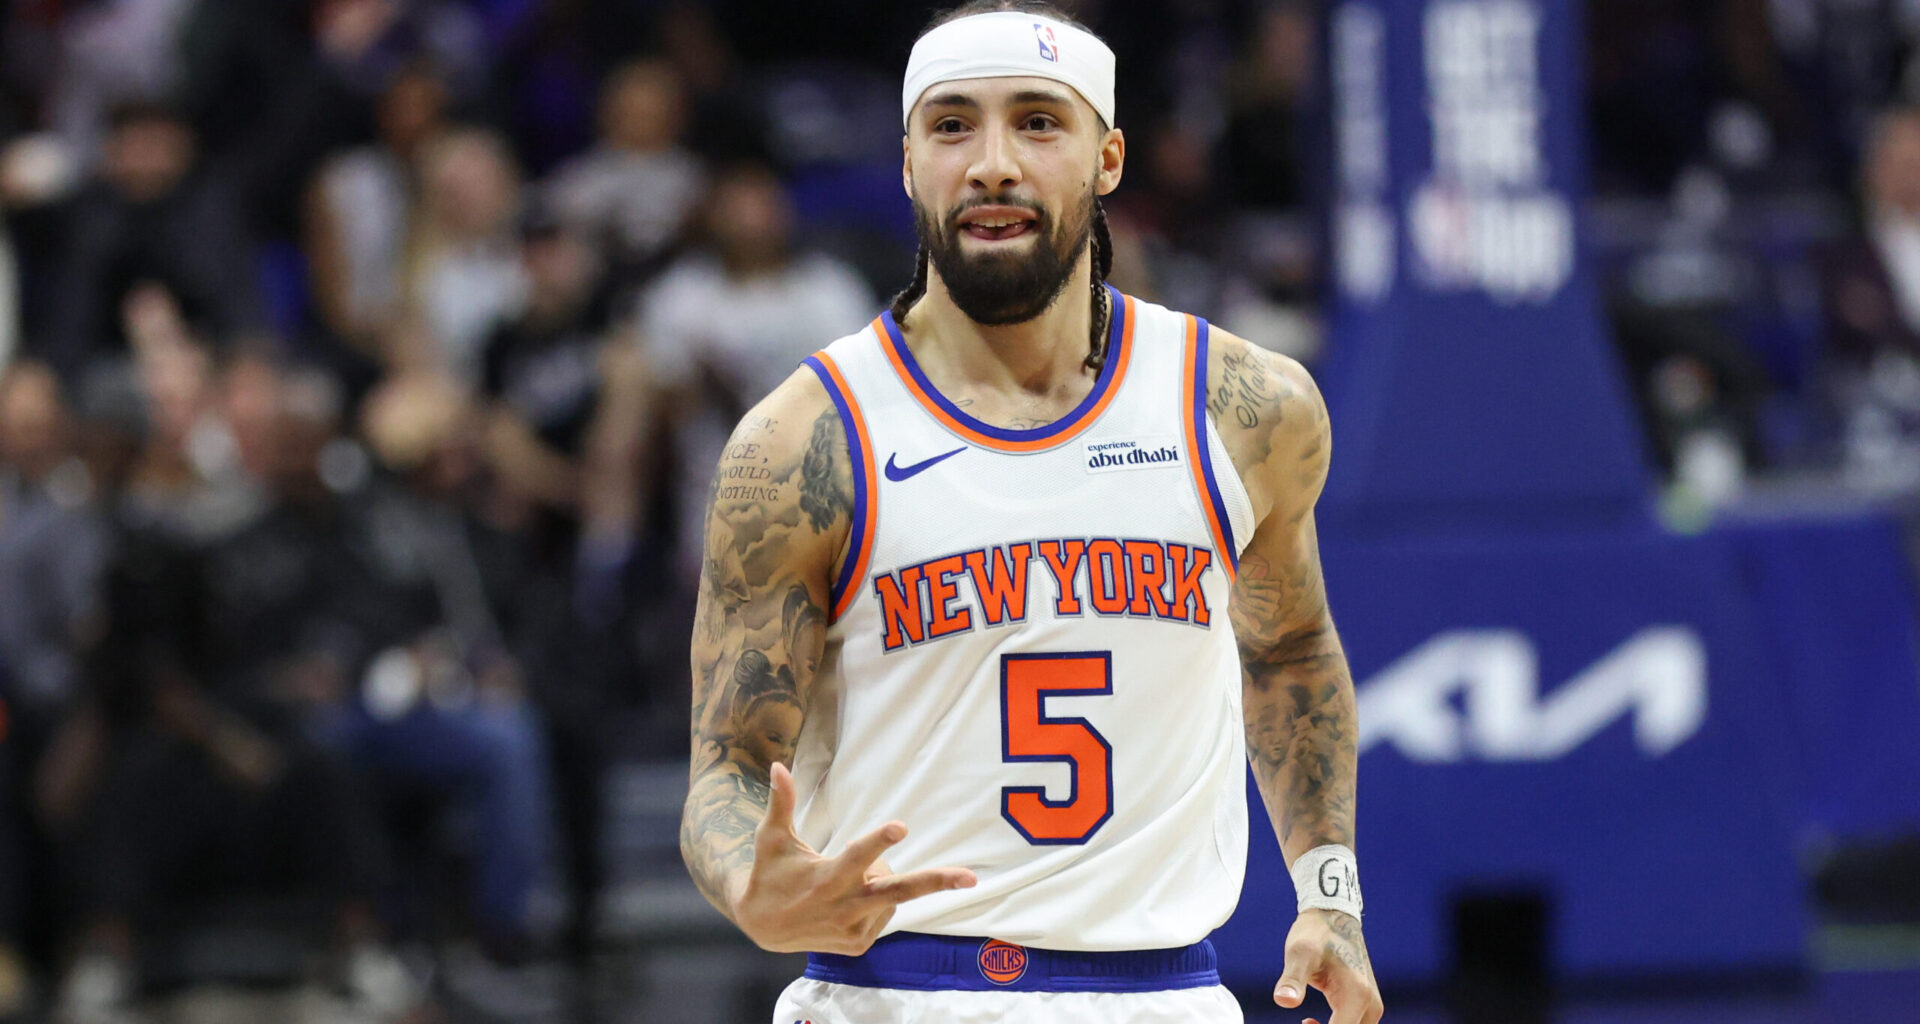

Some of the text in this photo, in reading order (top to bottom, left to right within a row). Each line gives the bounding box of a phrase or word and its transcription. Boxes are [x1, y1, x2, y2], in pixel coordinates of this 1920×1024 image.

[1087, 440, 1136, 452] experience
[1088, 446, 1179, 468] abu dhabi
[873, 537, 1213, 654] NEW YORK
[1000, 650, 1113, 845] 5
[984, 949, 1021, 971] KNICKS
